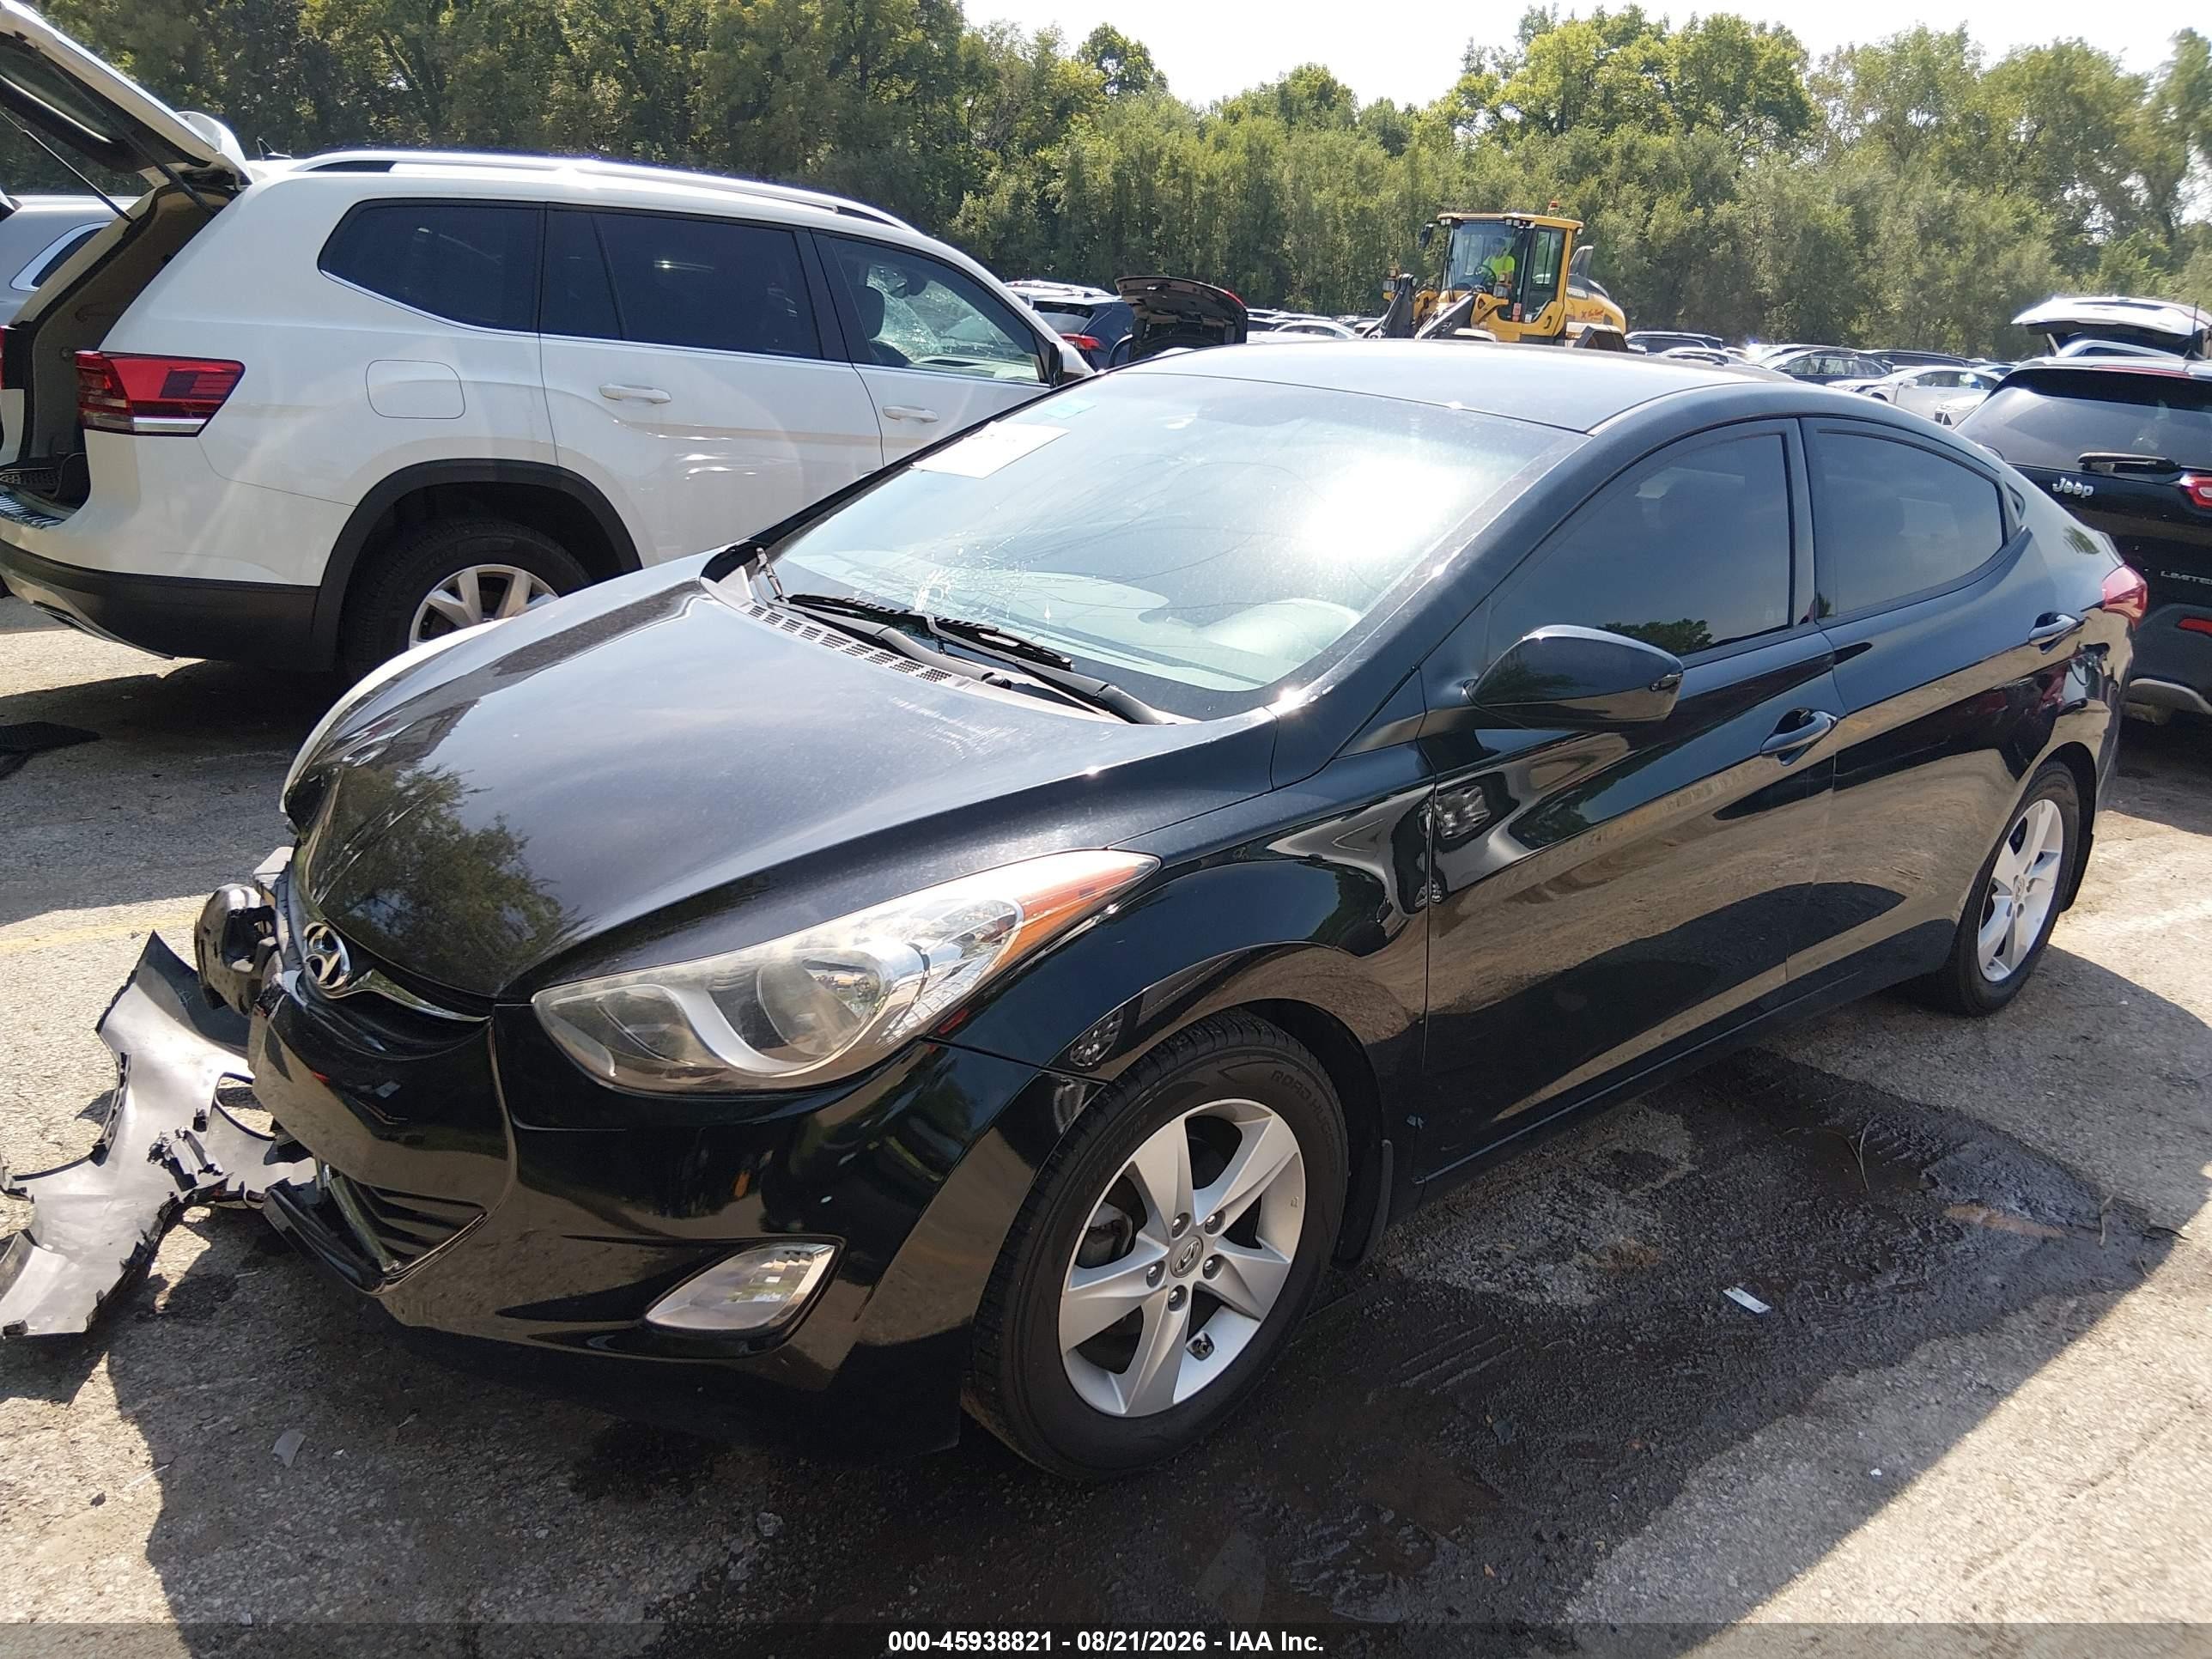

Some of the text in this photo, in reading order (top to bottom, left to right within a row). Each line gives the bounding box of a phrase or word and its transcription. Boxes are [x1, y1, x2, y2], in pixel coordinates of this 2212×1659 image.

[2051, 477, 2094, 499] Jeep
[2160, 570, 2212, 585] LIMITE
[1271, 1069, 1312, 1100] ROAD
